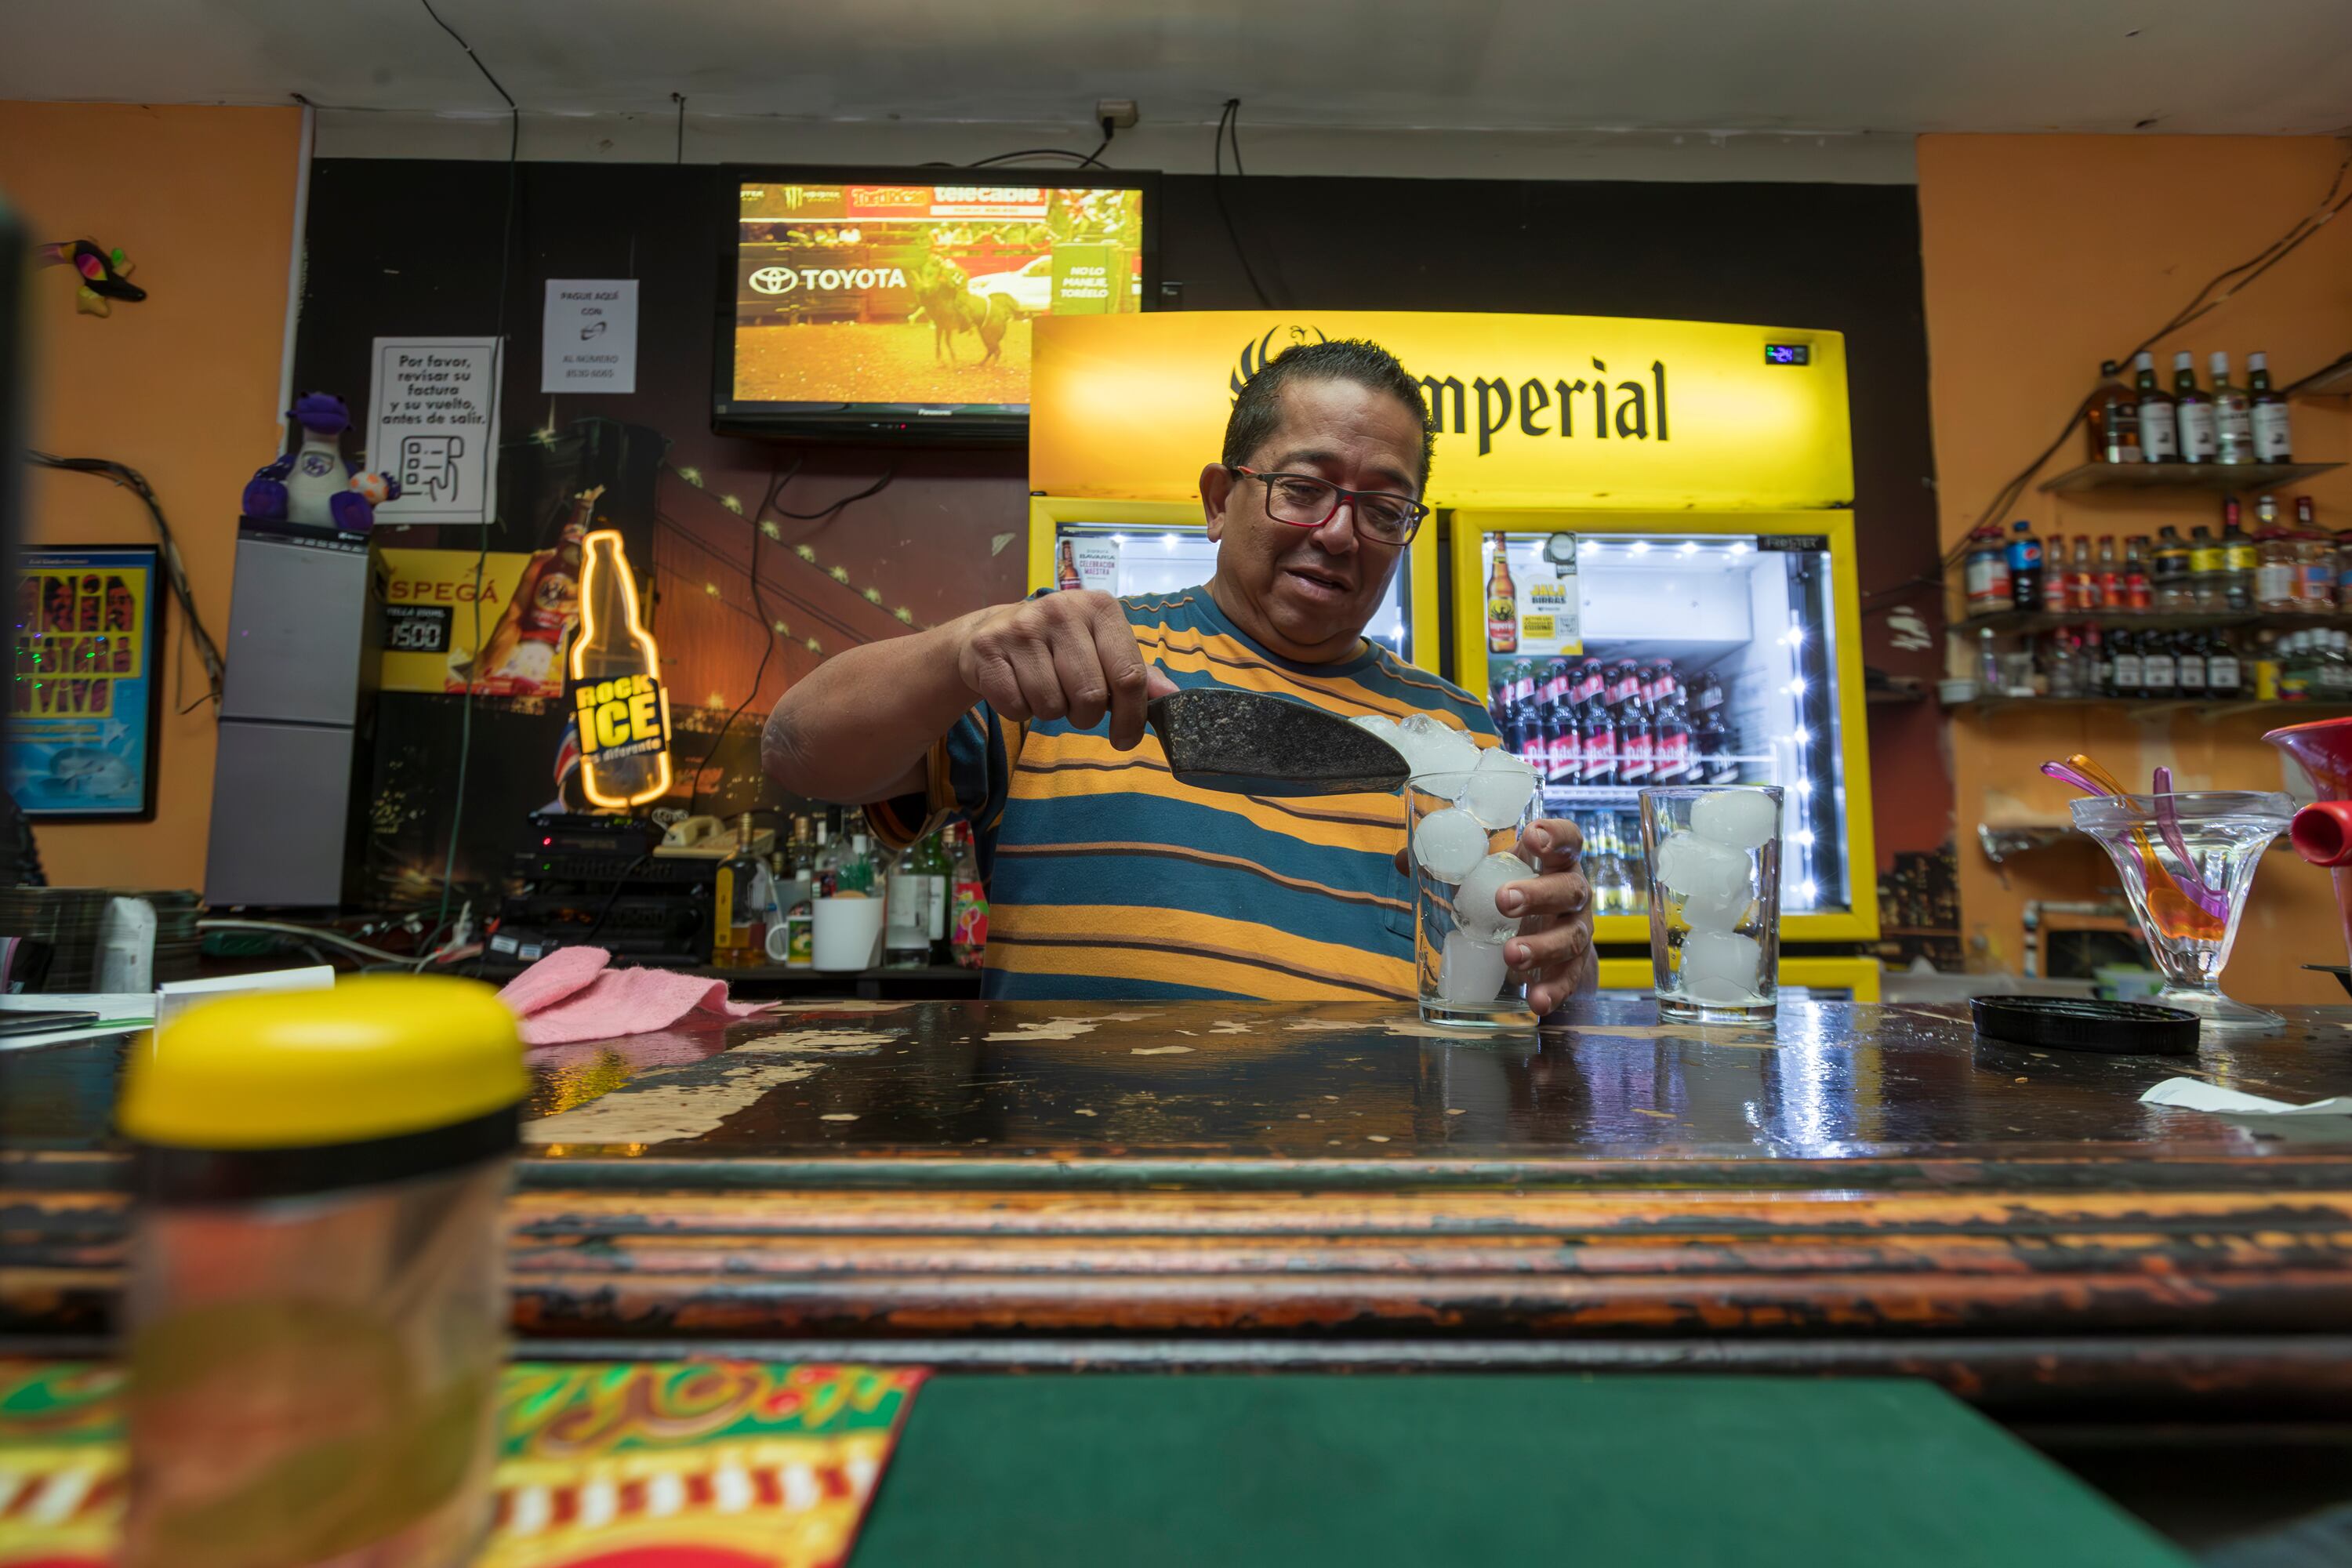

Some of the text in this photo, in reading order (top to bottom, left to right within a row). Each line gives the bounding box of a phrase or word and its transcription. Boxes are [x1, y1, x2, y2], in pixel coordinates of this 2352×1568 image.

[800, 268, 907, 290] TOYOTA
[399, 355, 471, 368] Por favor,
[397, 371, 471, 382] revisar su
[408, 384, 459, 396] factura
[390, 397, 476, 413] y su vuelto,
[1412, 356, 1669, 456] mperial
[382, 412, 486, 425] antes de salir.
[390, 579, 499, 604] SPEGÁ
[575, 674, 655, 710] ROCK
[578, 691, 660, 754] ICE
